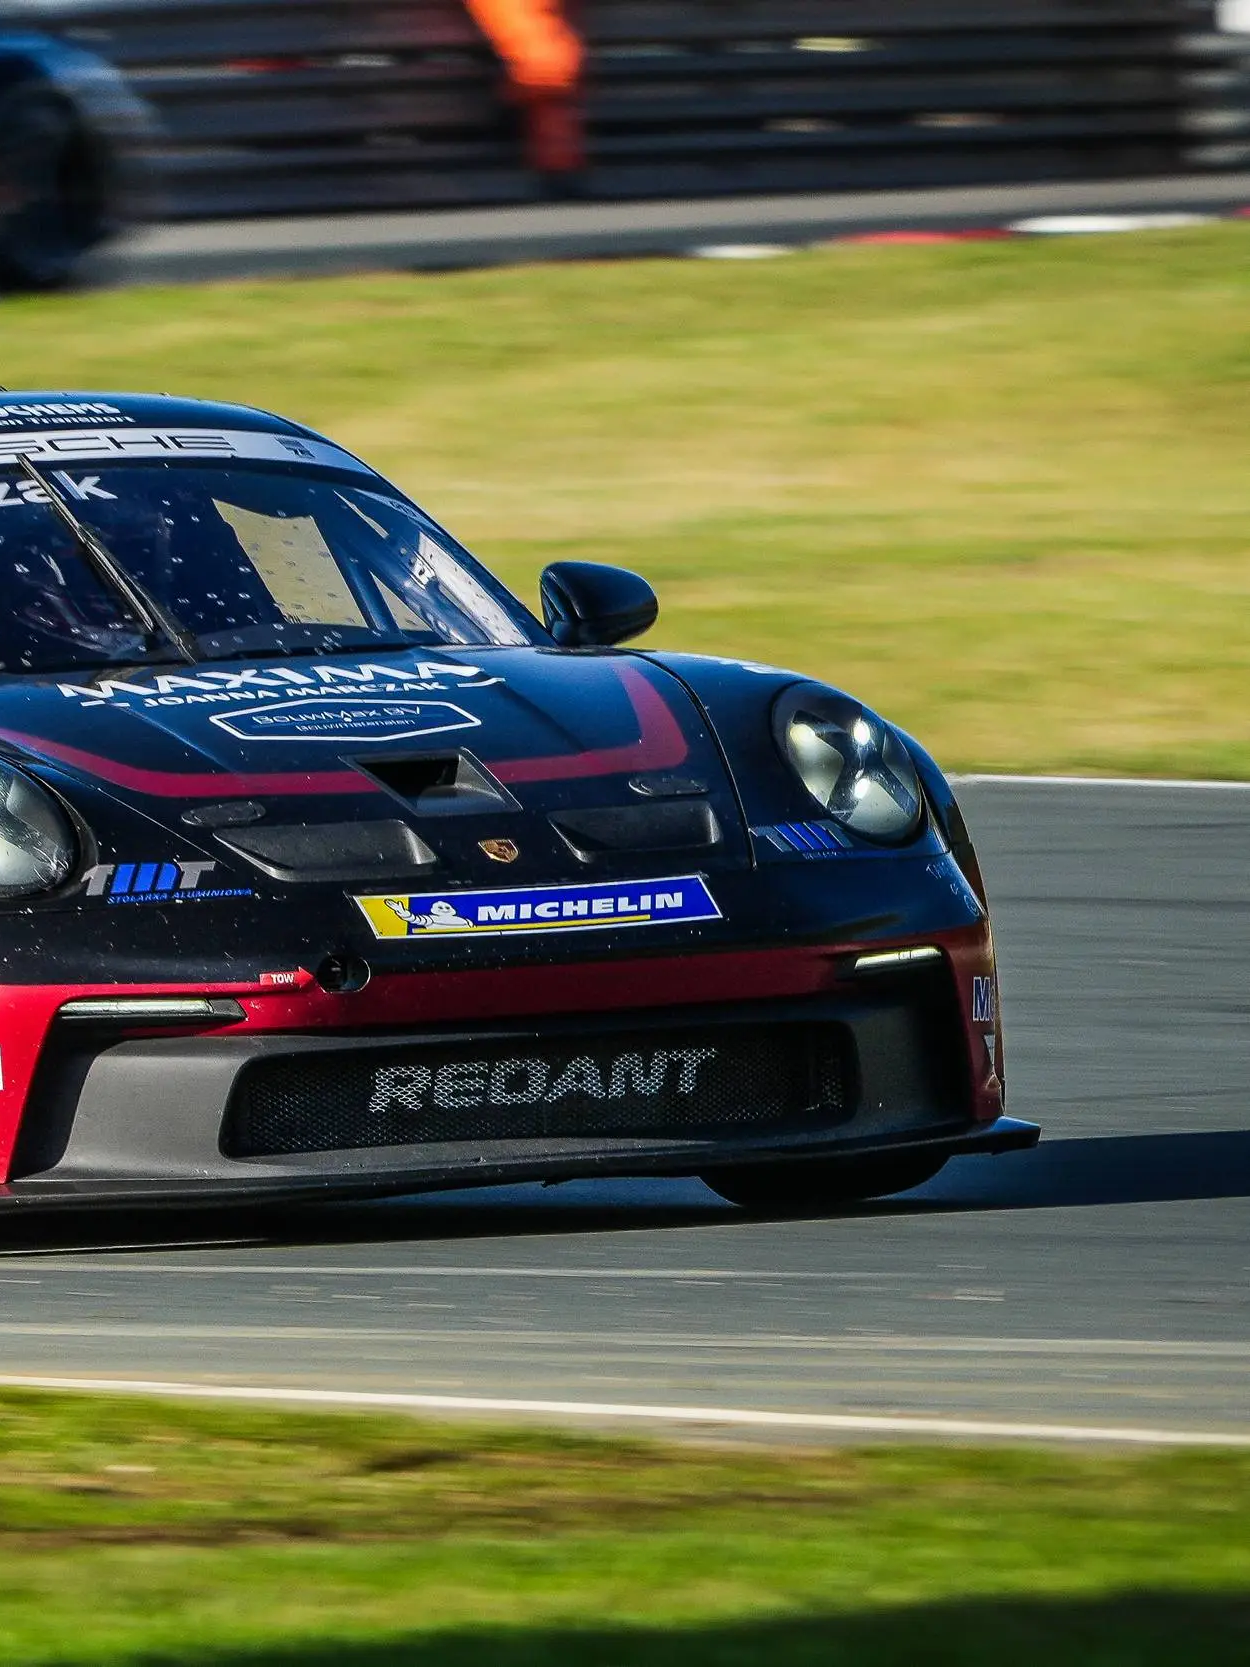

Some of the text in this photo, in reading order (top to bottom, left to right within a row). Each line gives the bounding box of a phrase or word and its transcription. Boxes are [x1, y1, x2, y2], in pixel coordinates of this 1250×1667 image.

[56, 661, 484, 699] MAXIMA
[144, 681, 450, 707] JOANNA MARCZAK
[478, 892, 684, 922] MICHELIN
[271, 973, 295, 984] TOW
[367, 1048, 717, 1113] REDANT
